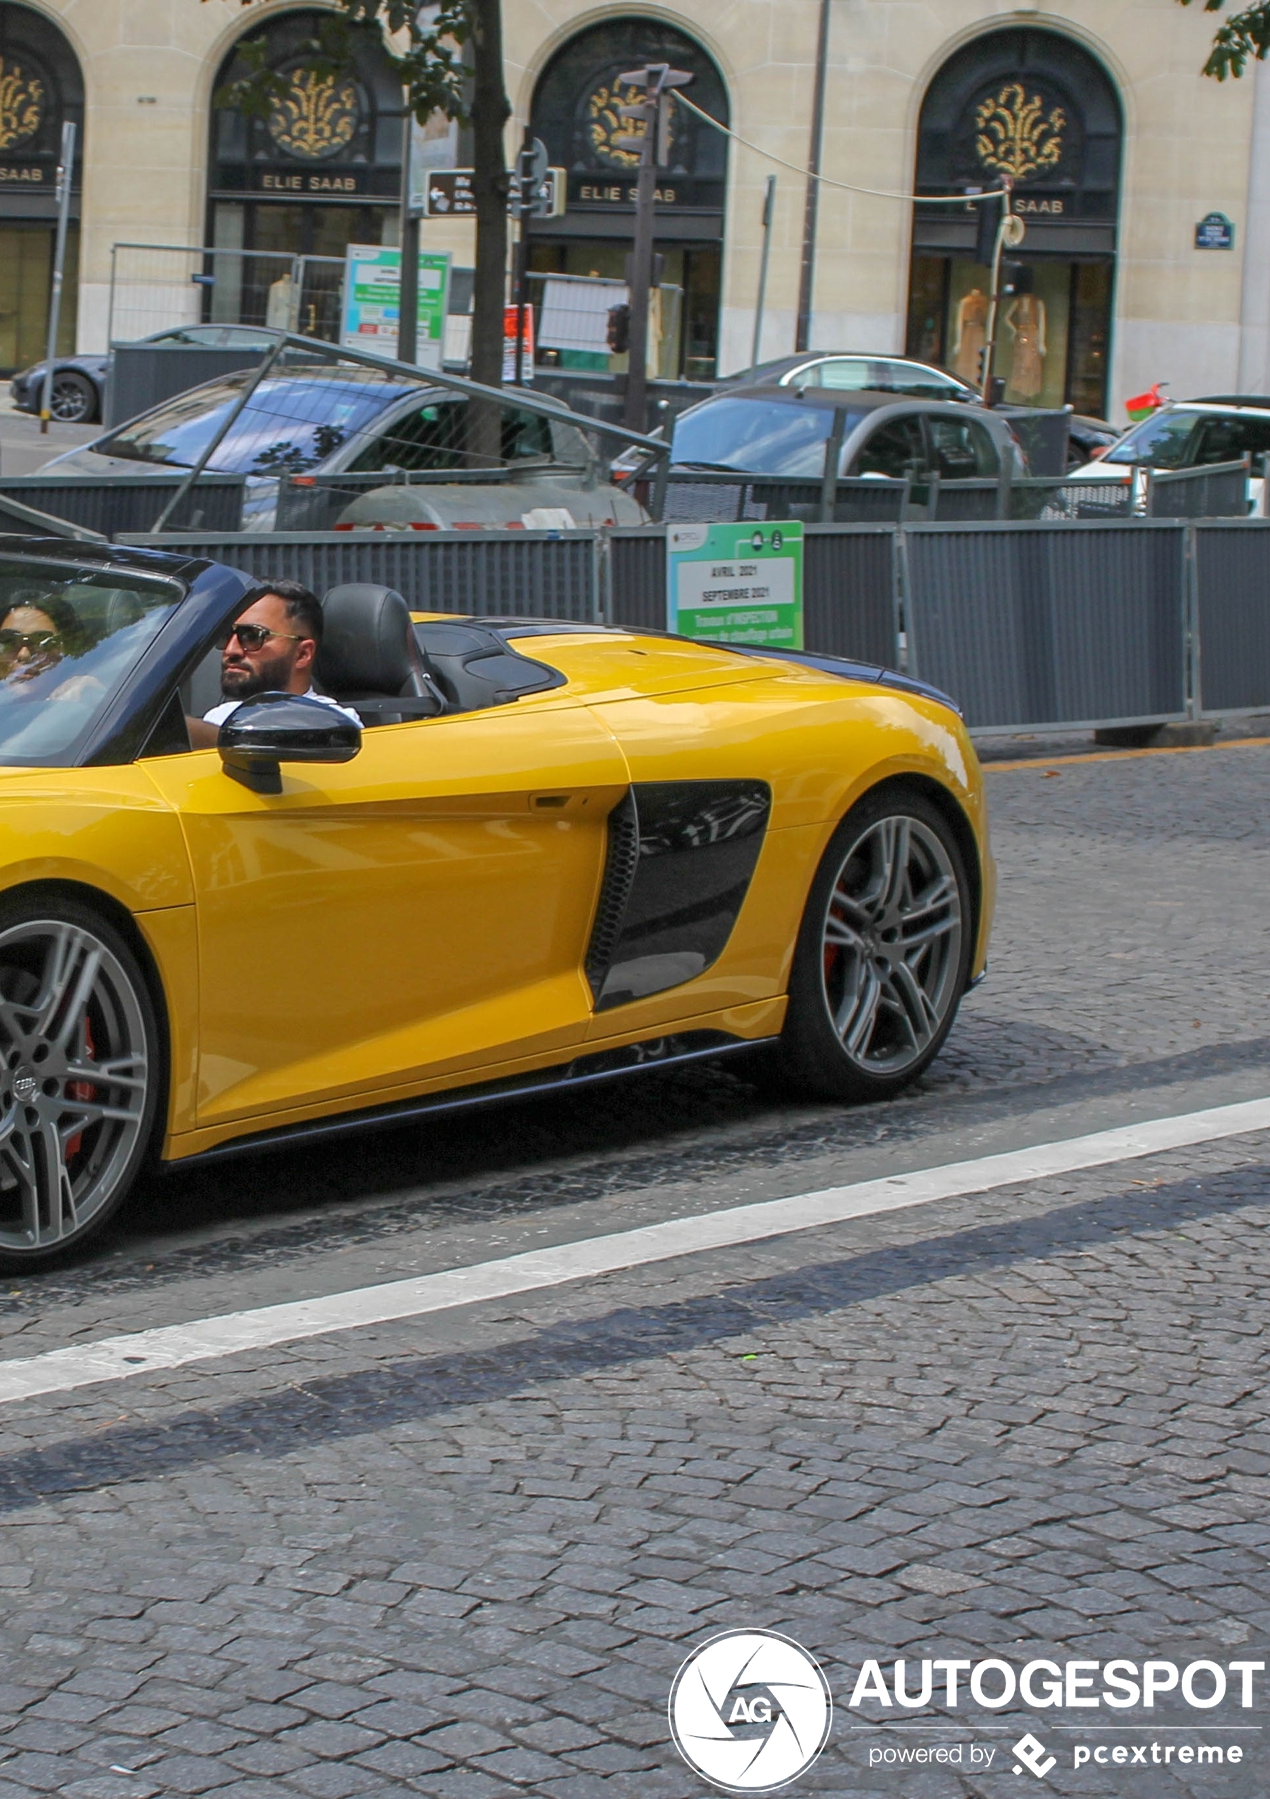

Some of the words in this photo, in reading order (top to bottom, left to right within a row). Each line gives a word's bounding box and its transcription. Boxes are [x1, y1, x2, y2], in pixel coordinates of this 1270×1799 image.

[263, 174, 303, 188] ELIE
[310, 176, 357, 191] SAAB
[580, 186, 622, 200] ELIE
[629, 187, 675, 202] SAB
[1014, 199, 1063, 213] SAAB
[711, 566, 735, 578] AVRIL
[739, 565, 757, 577] 2021
[702, 588, 749, 602] SEPTEMBRE
[751, 586, 769, 599] 2021
